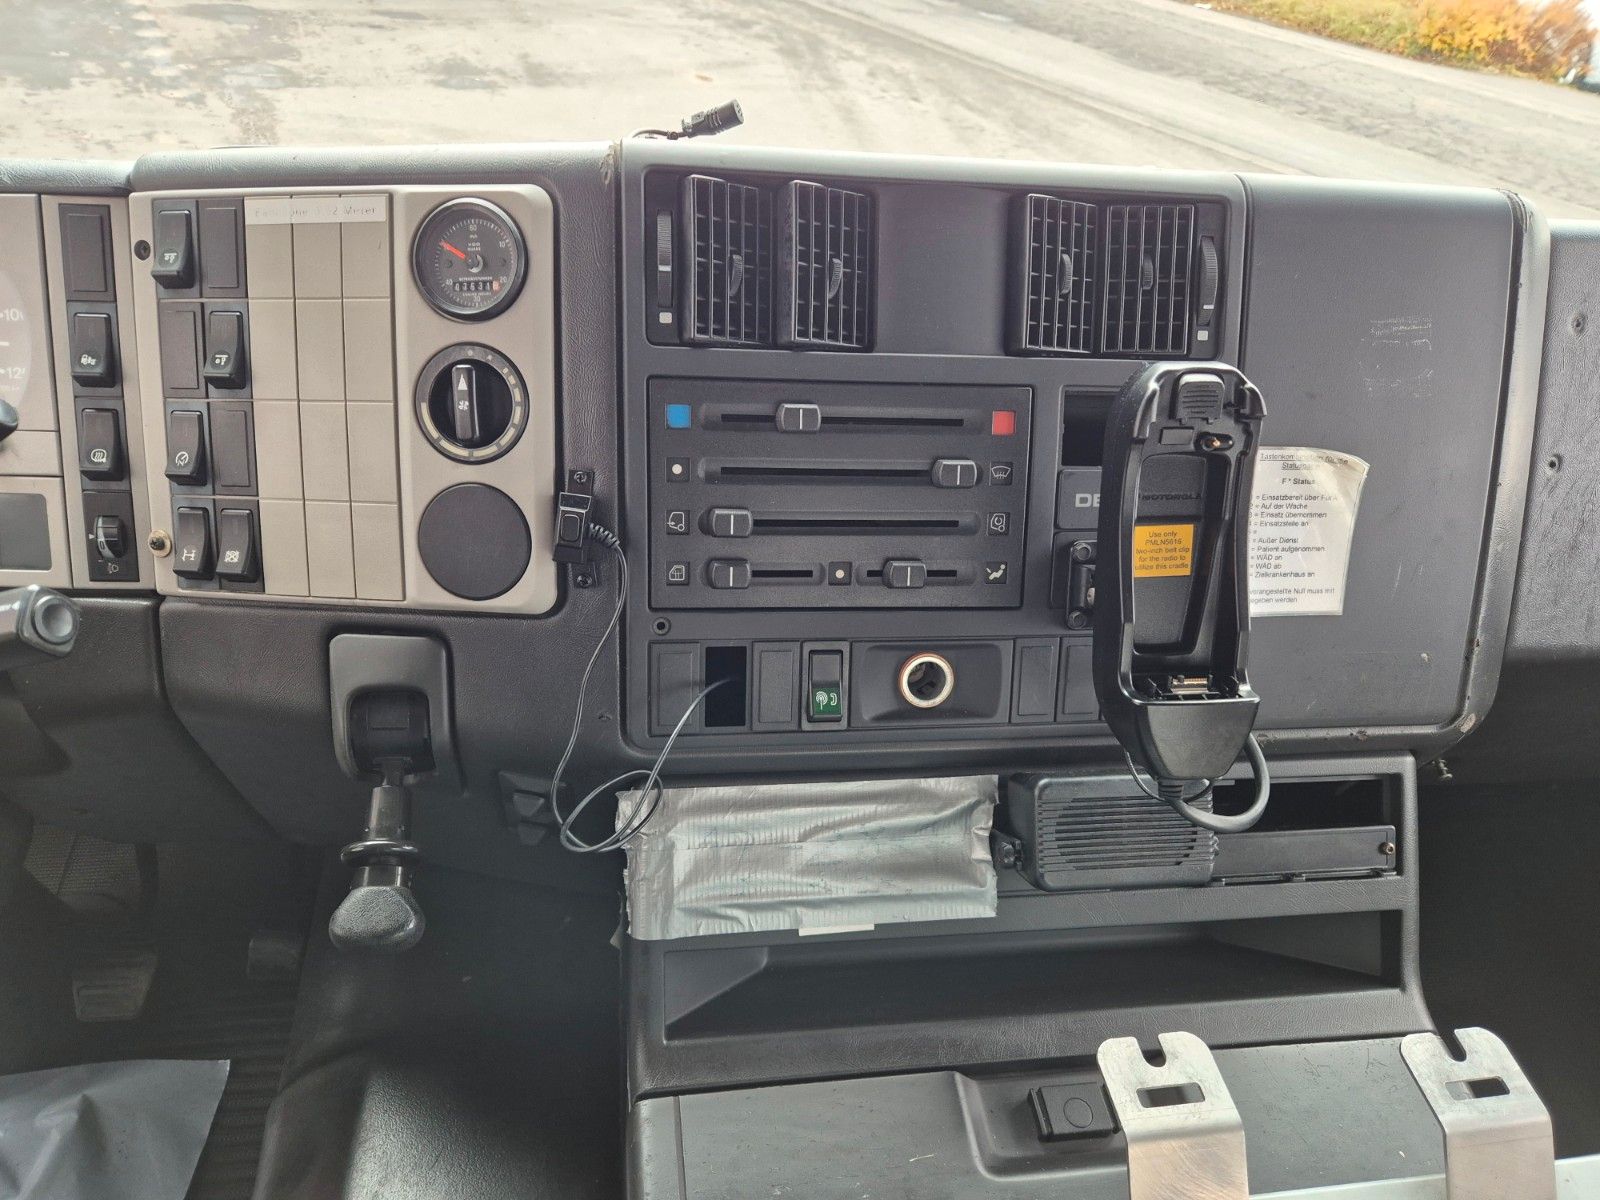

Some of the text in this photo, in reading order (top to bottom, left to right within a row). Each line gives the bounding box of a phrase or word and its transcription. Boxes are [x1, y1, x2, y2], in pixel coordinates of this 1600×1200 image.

[1261, 493, 1303, 501] Einsatzbereit
[1304, 493, 1319, 501] über
[1261, 502, 1272, 510] Auf
[1273, 502, 1284, 510] der
[1285, 502, 1308, 510] Wache
[1260, 511, 1284, 519] Einsatz
[1285, 511, 1327, 519] übernommen
[1148, 530, 1178, 538] Use only
[1279, 536, 1299, 544] Dienst
[1257, 545, 1280, 553] Patient
[1281, 545, 1326, 554] aufgenommen
[1138, 555, 1148, 563] for
[1161, 554, 1178, 562] radio
[1168, 561, 1189, 570] cradle
[1293, 587, 1305, 595] Null
[1274, 596, 1298, 604] werden
